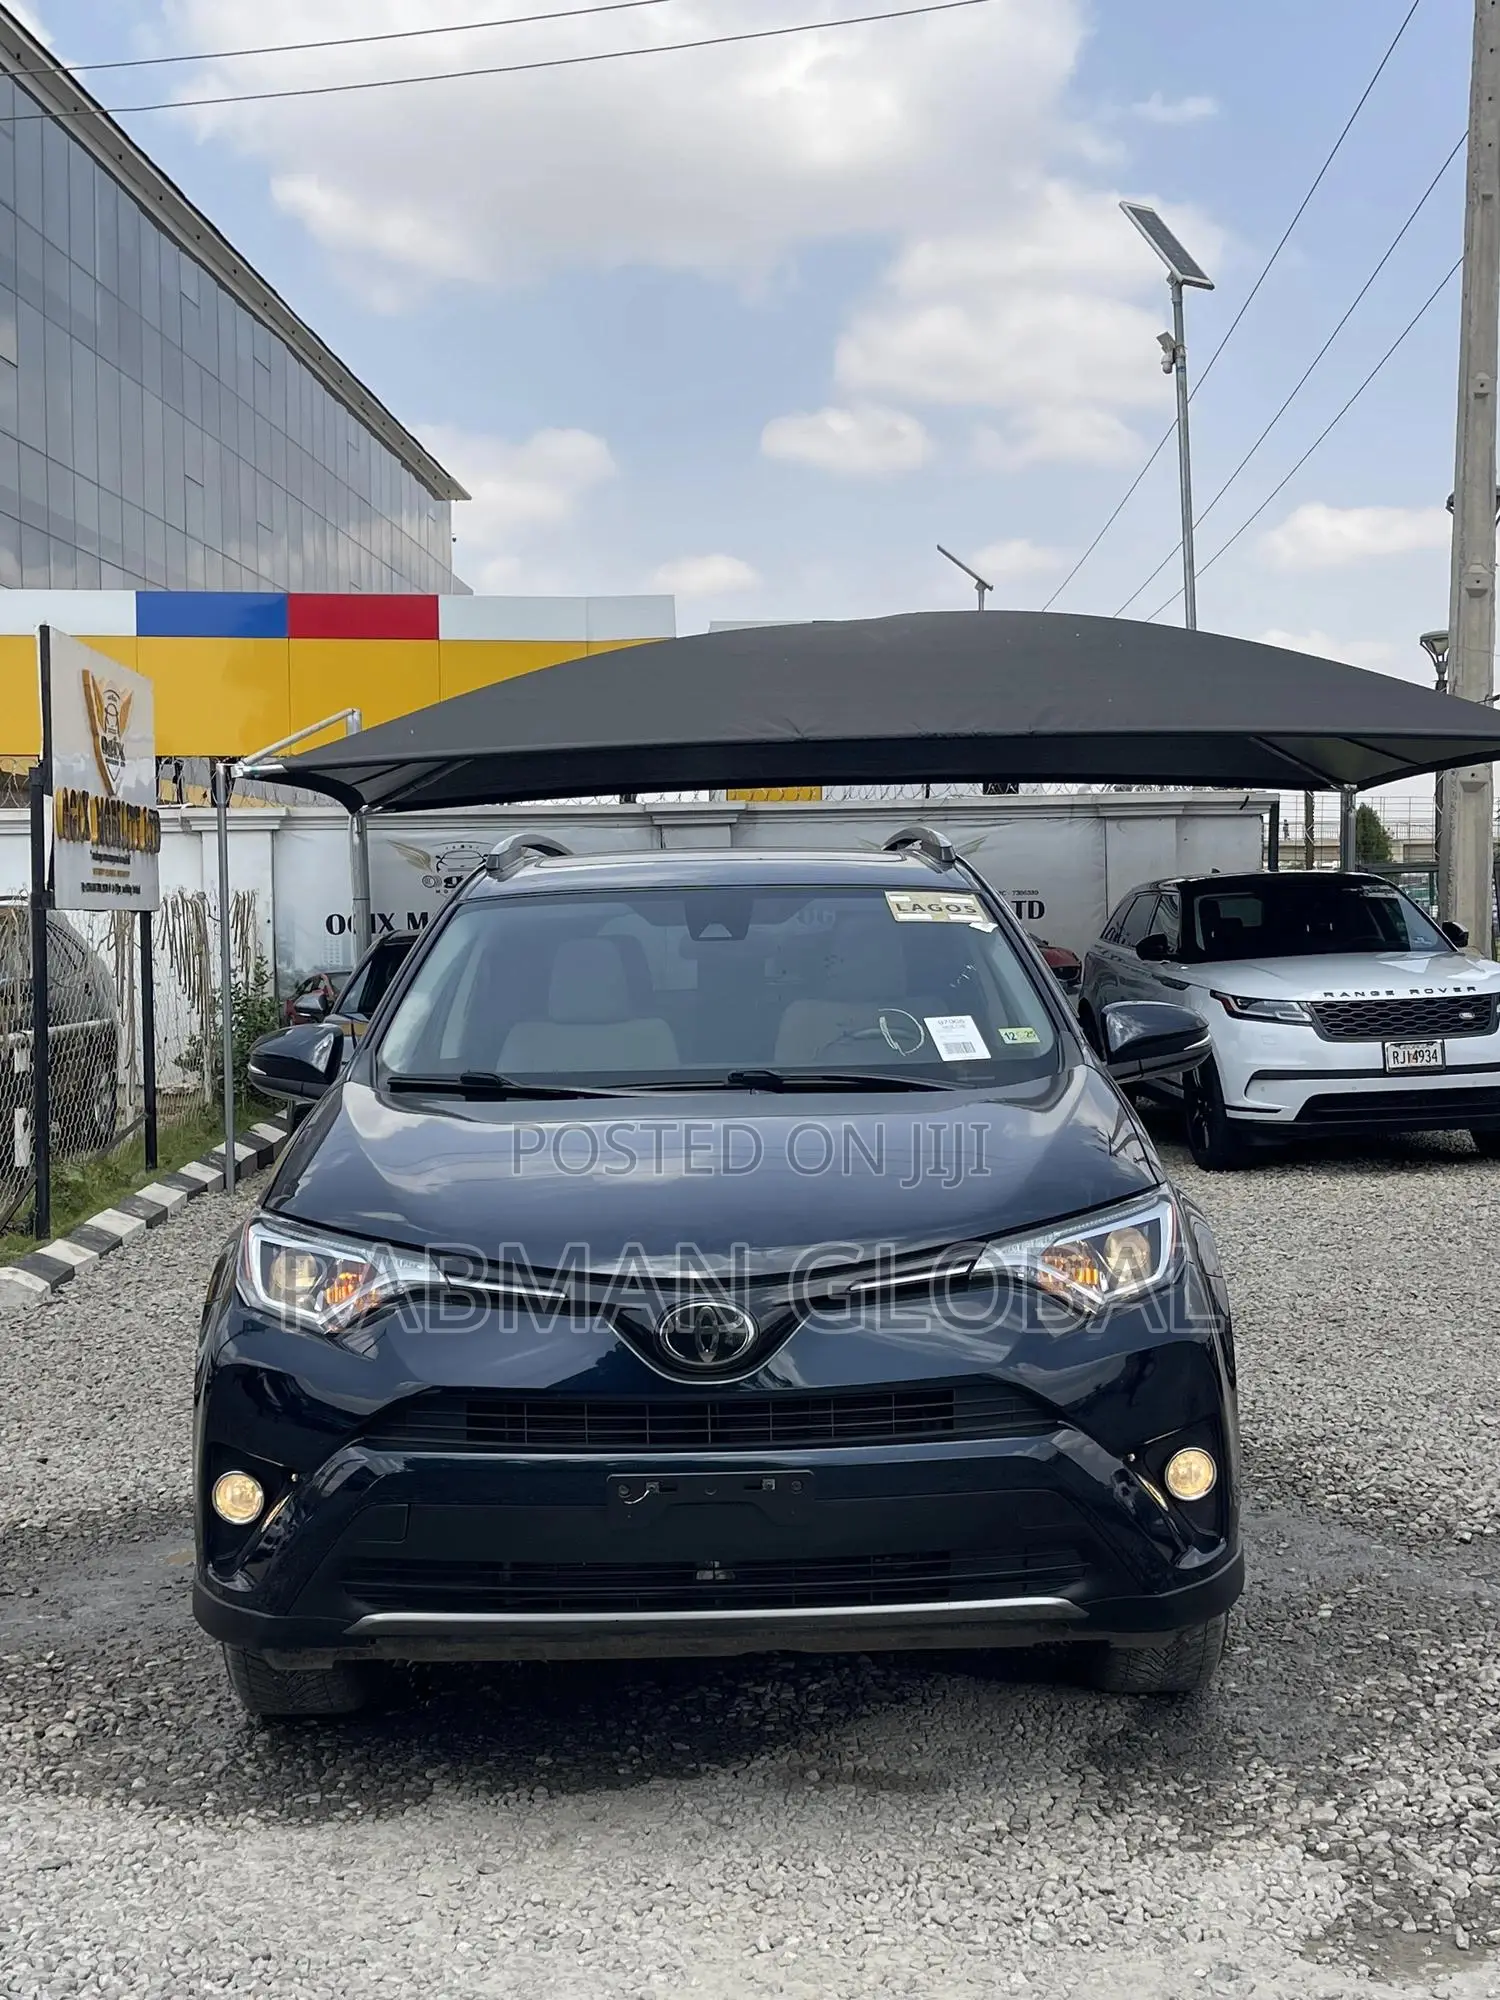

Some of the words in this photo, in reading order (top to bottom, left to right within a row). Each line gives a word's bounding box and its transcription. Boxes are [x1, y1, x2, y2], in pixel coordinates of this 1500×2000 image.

[896, 903, 977, 914] LAGOS
[1011, 900, 1045, 920] TD
[1323, 989, 1396, 998] RANGE
[1409, 986, 1477, 995] ROVER
[1004, 1031, 1017, 1041] 12
